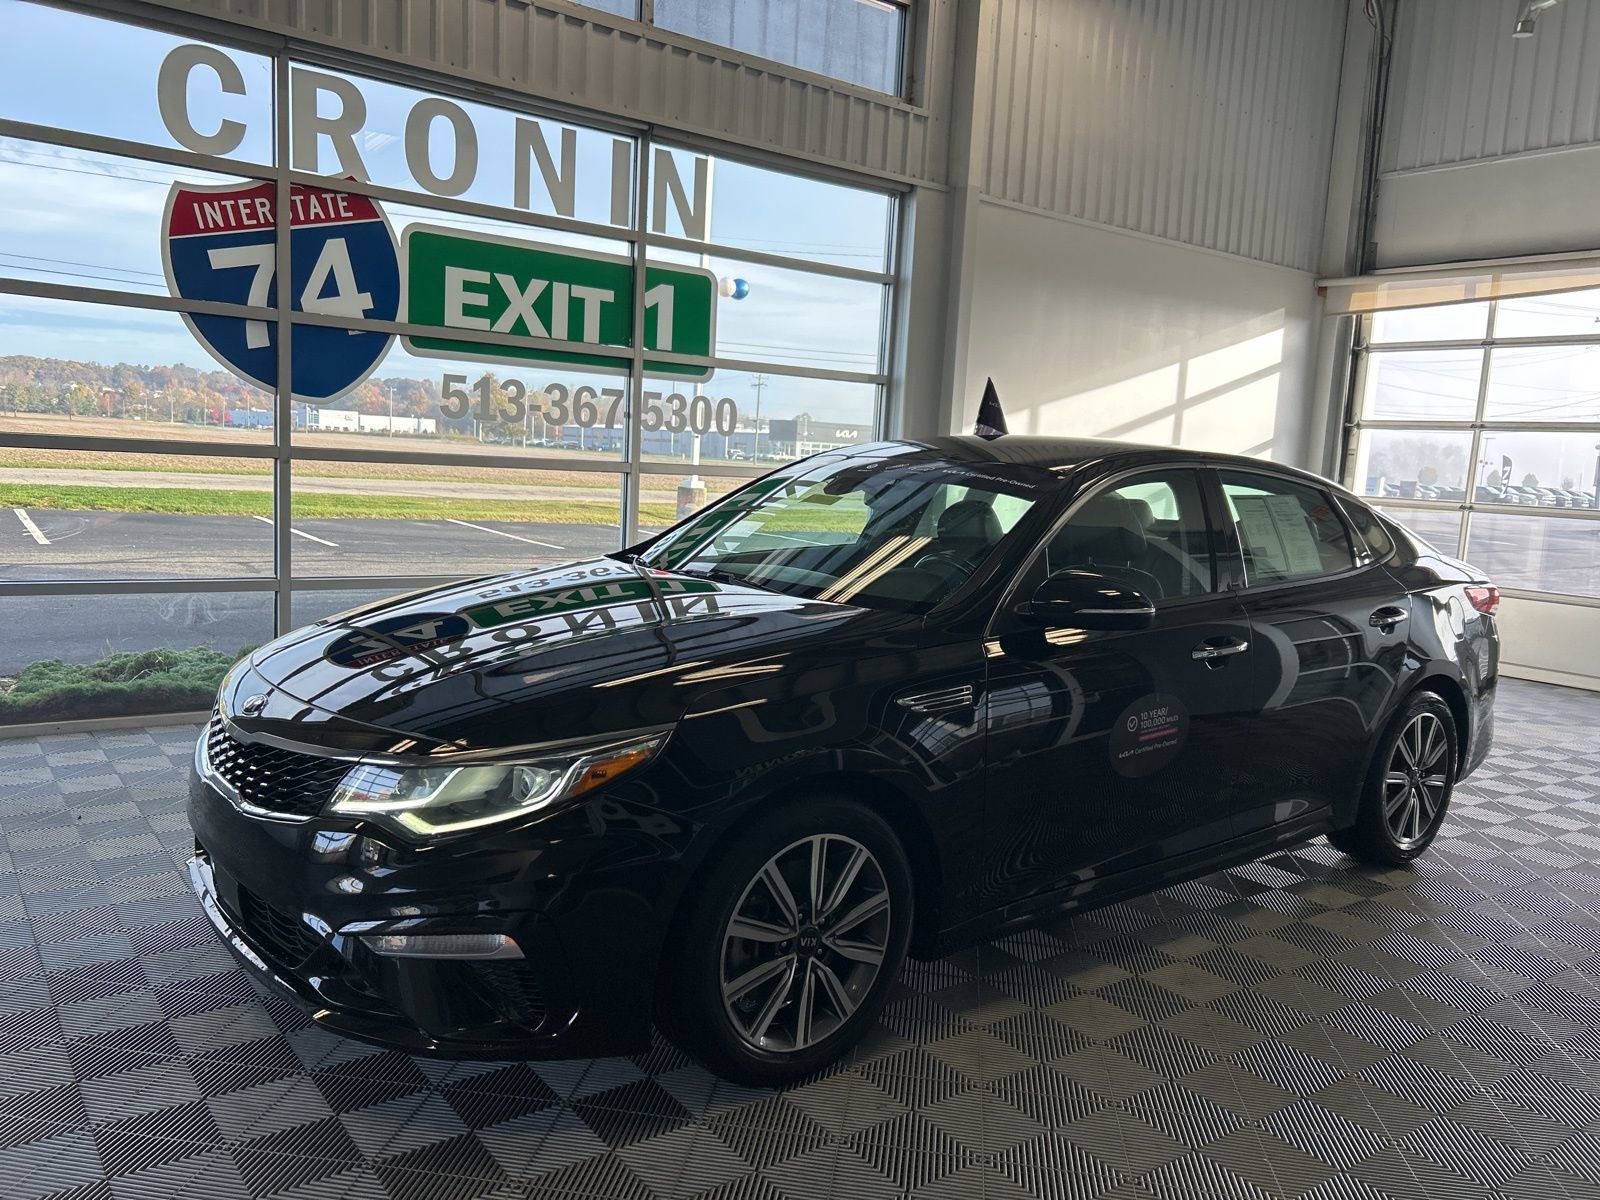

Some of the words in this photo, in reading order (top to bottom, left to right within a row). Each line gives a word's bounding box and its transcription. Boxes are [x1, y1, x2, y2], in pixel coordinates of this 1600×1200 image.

[157, 43, 708, 241] CRONIN
[193, 193, 354, 230] INTERTATE
[207, 238, 374, 349] 74
[444, 265, 615, 345] EXIT
[644, 284, 675, 351] 1
[440, 373, 738, 436] 513-3675300
[1140, 712, 1148, 721] 10
